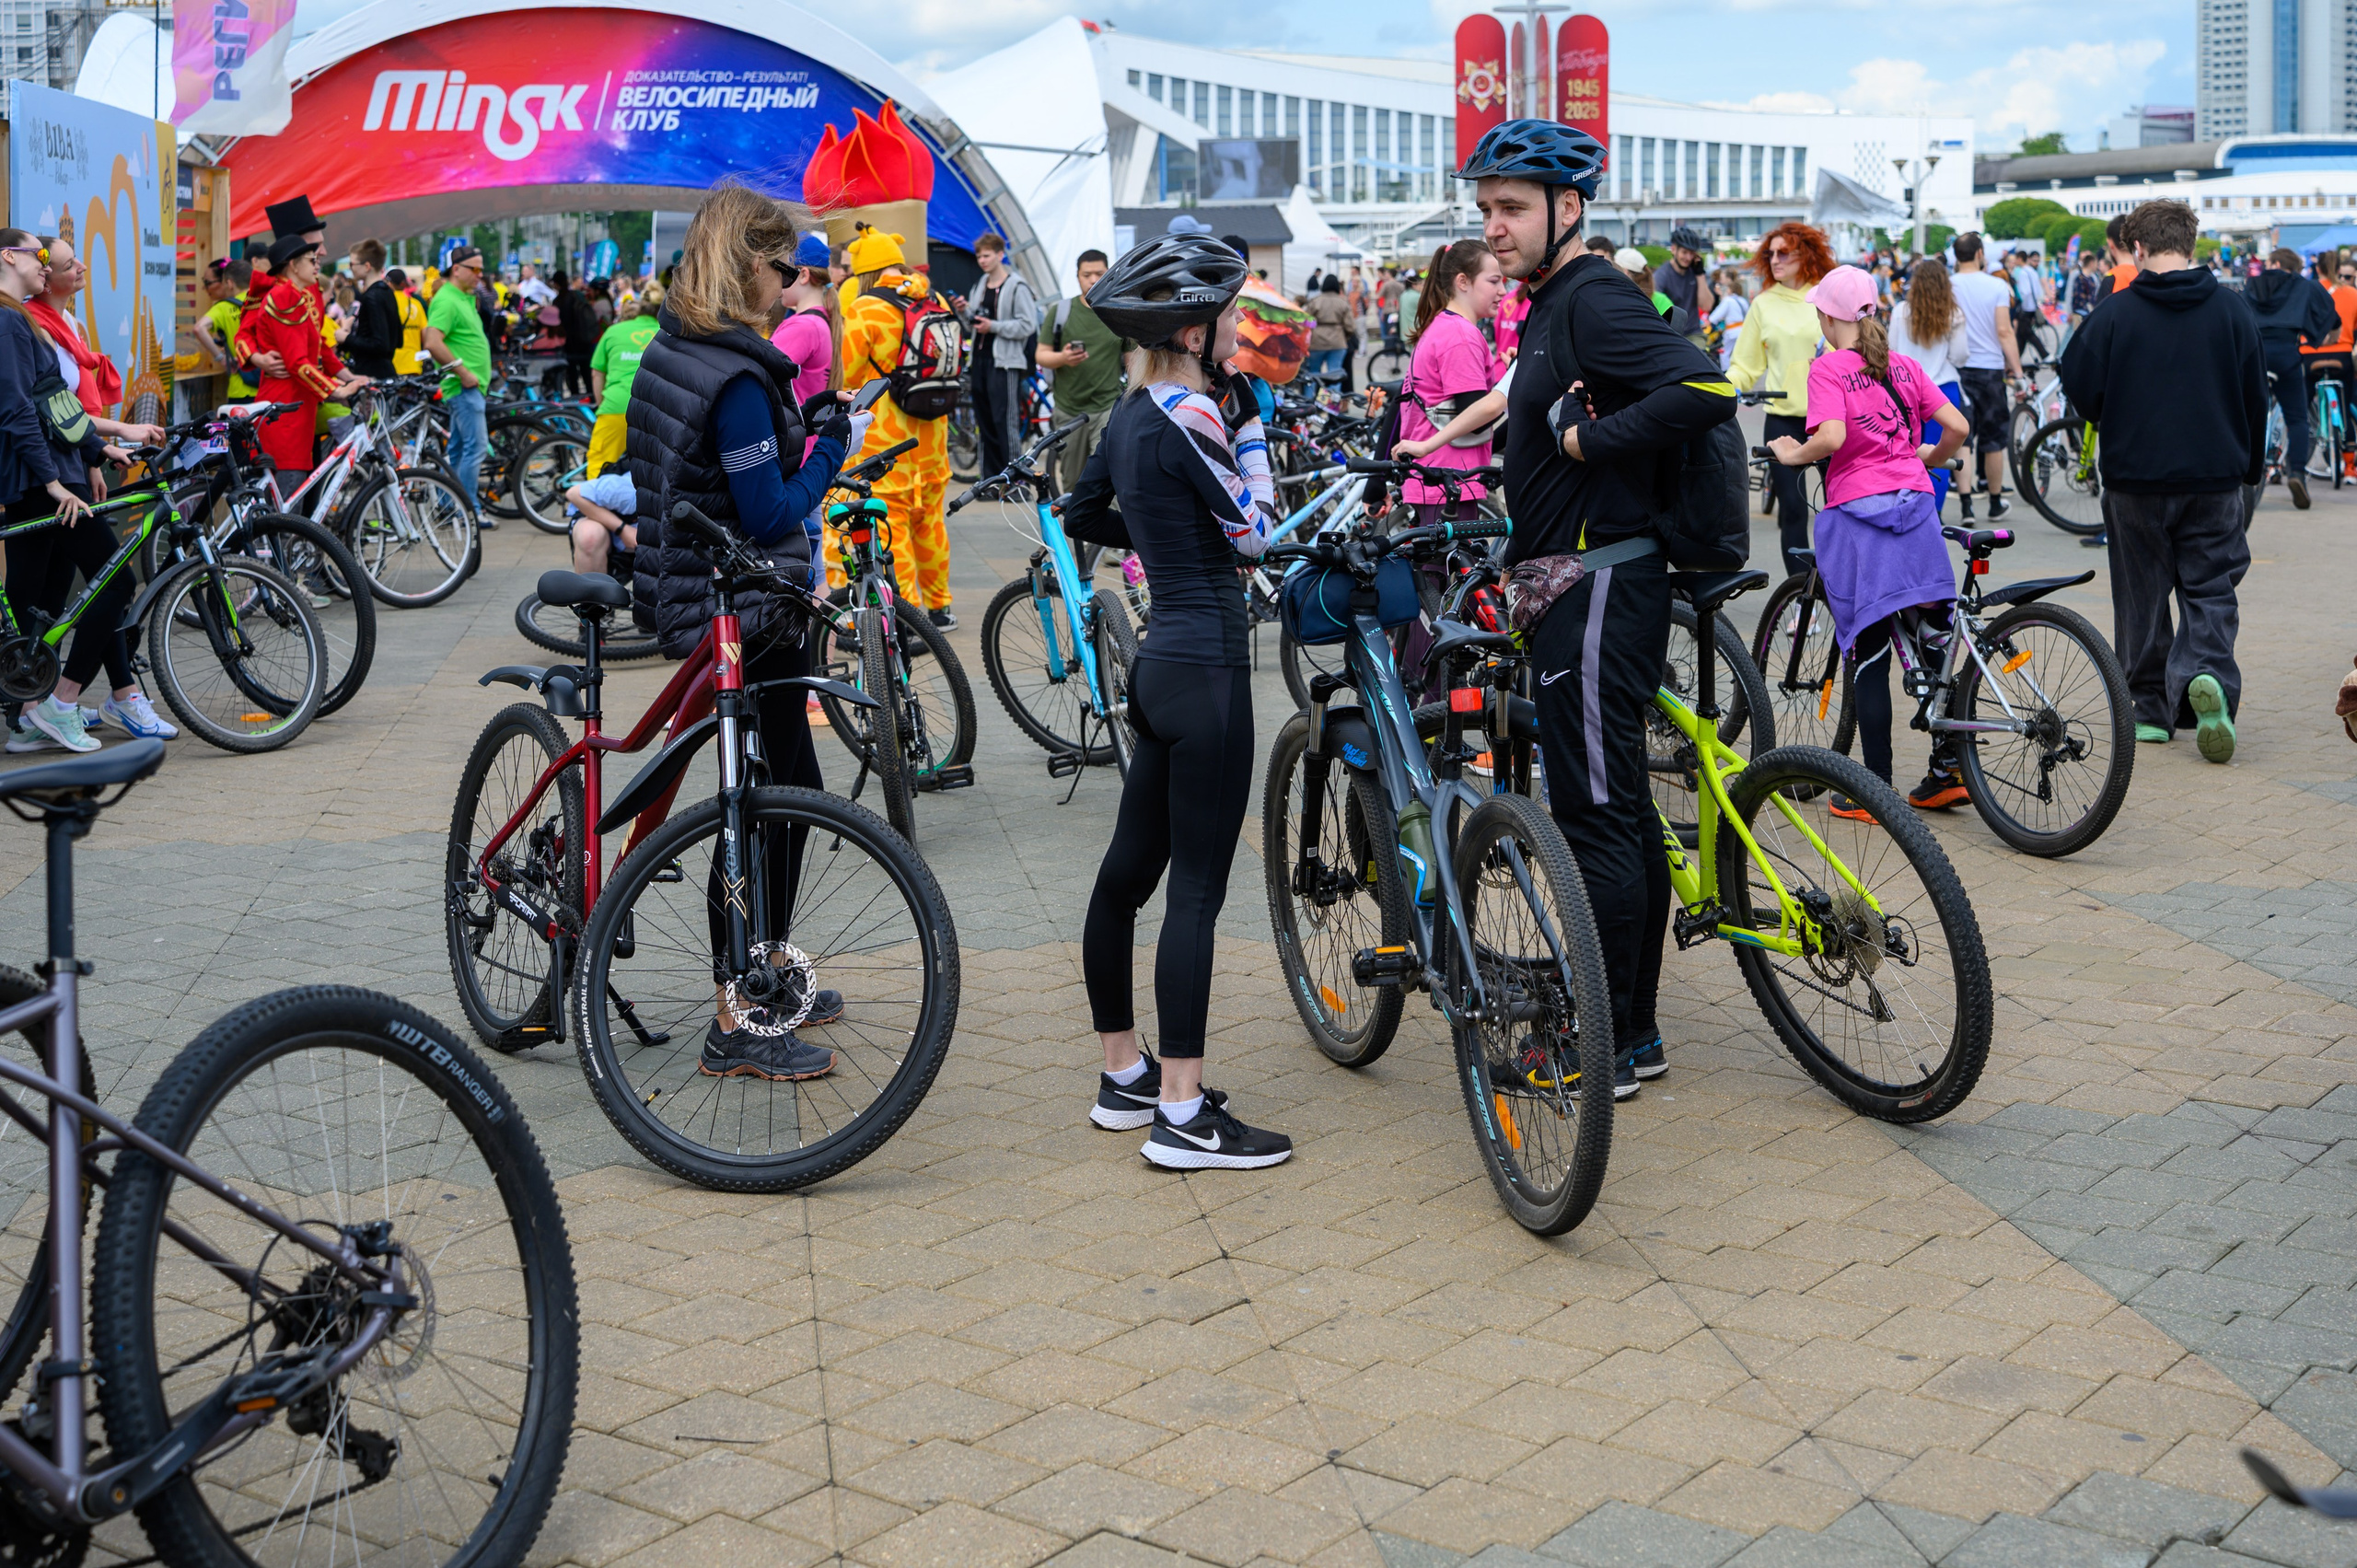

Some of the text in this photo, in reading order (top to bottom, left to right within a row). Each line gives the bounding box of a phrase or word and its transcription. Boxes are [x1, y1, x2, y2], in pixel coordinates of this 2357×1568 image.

[623, 70, 734, 84] ДОКАЗАТЕЛЬСТВО
[742, 72, 809, 84] РЕЗУЛЬТАТ!
[616, 83, 819, 113] ВЕЛОСИПЕДНЫЙ
[1567, 78, 1600, 99] 1945
[1564, 100, 1600, 120] 2025
[610, 110, 680, 131] КЛУБ
[1180, 293, 1215, 302] GIRO
[1365, 626, 1382, 638] LTD
[1341, 742, 1360, 756] Mud
[1344, 753, 1368, 768] Guard
[583, 1016, 594, 1050] TERRA
[396, 1023, 494, 1110] WTB RANGER
